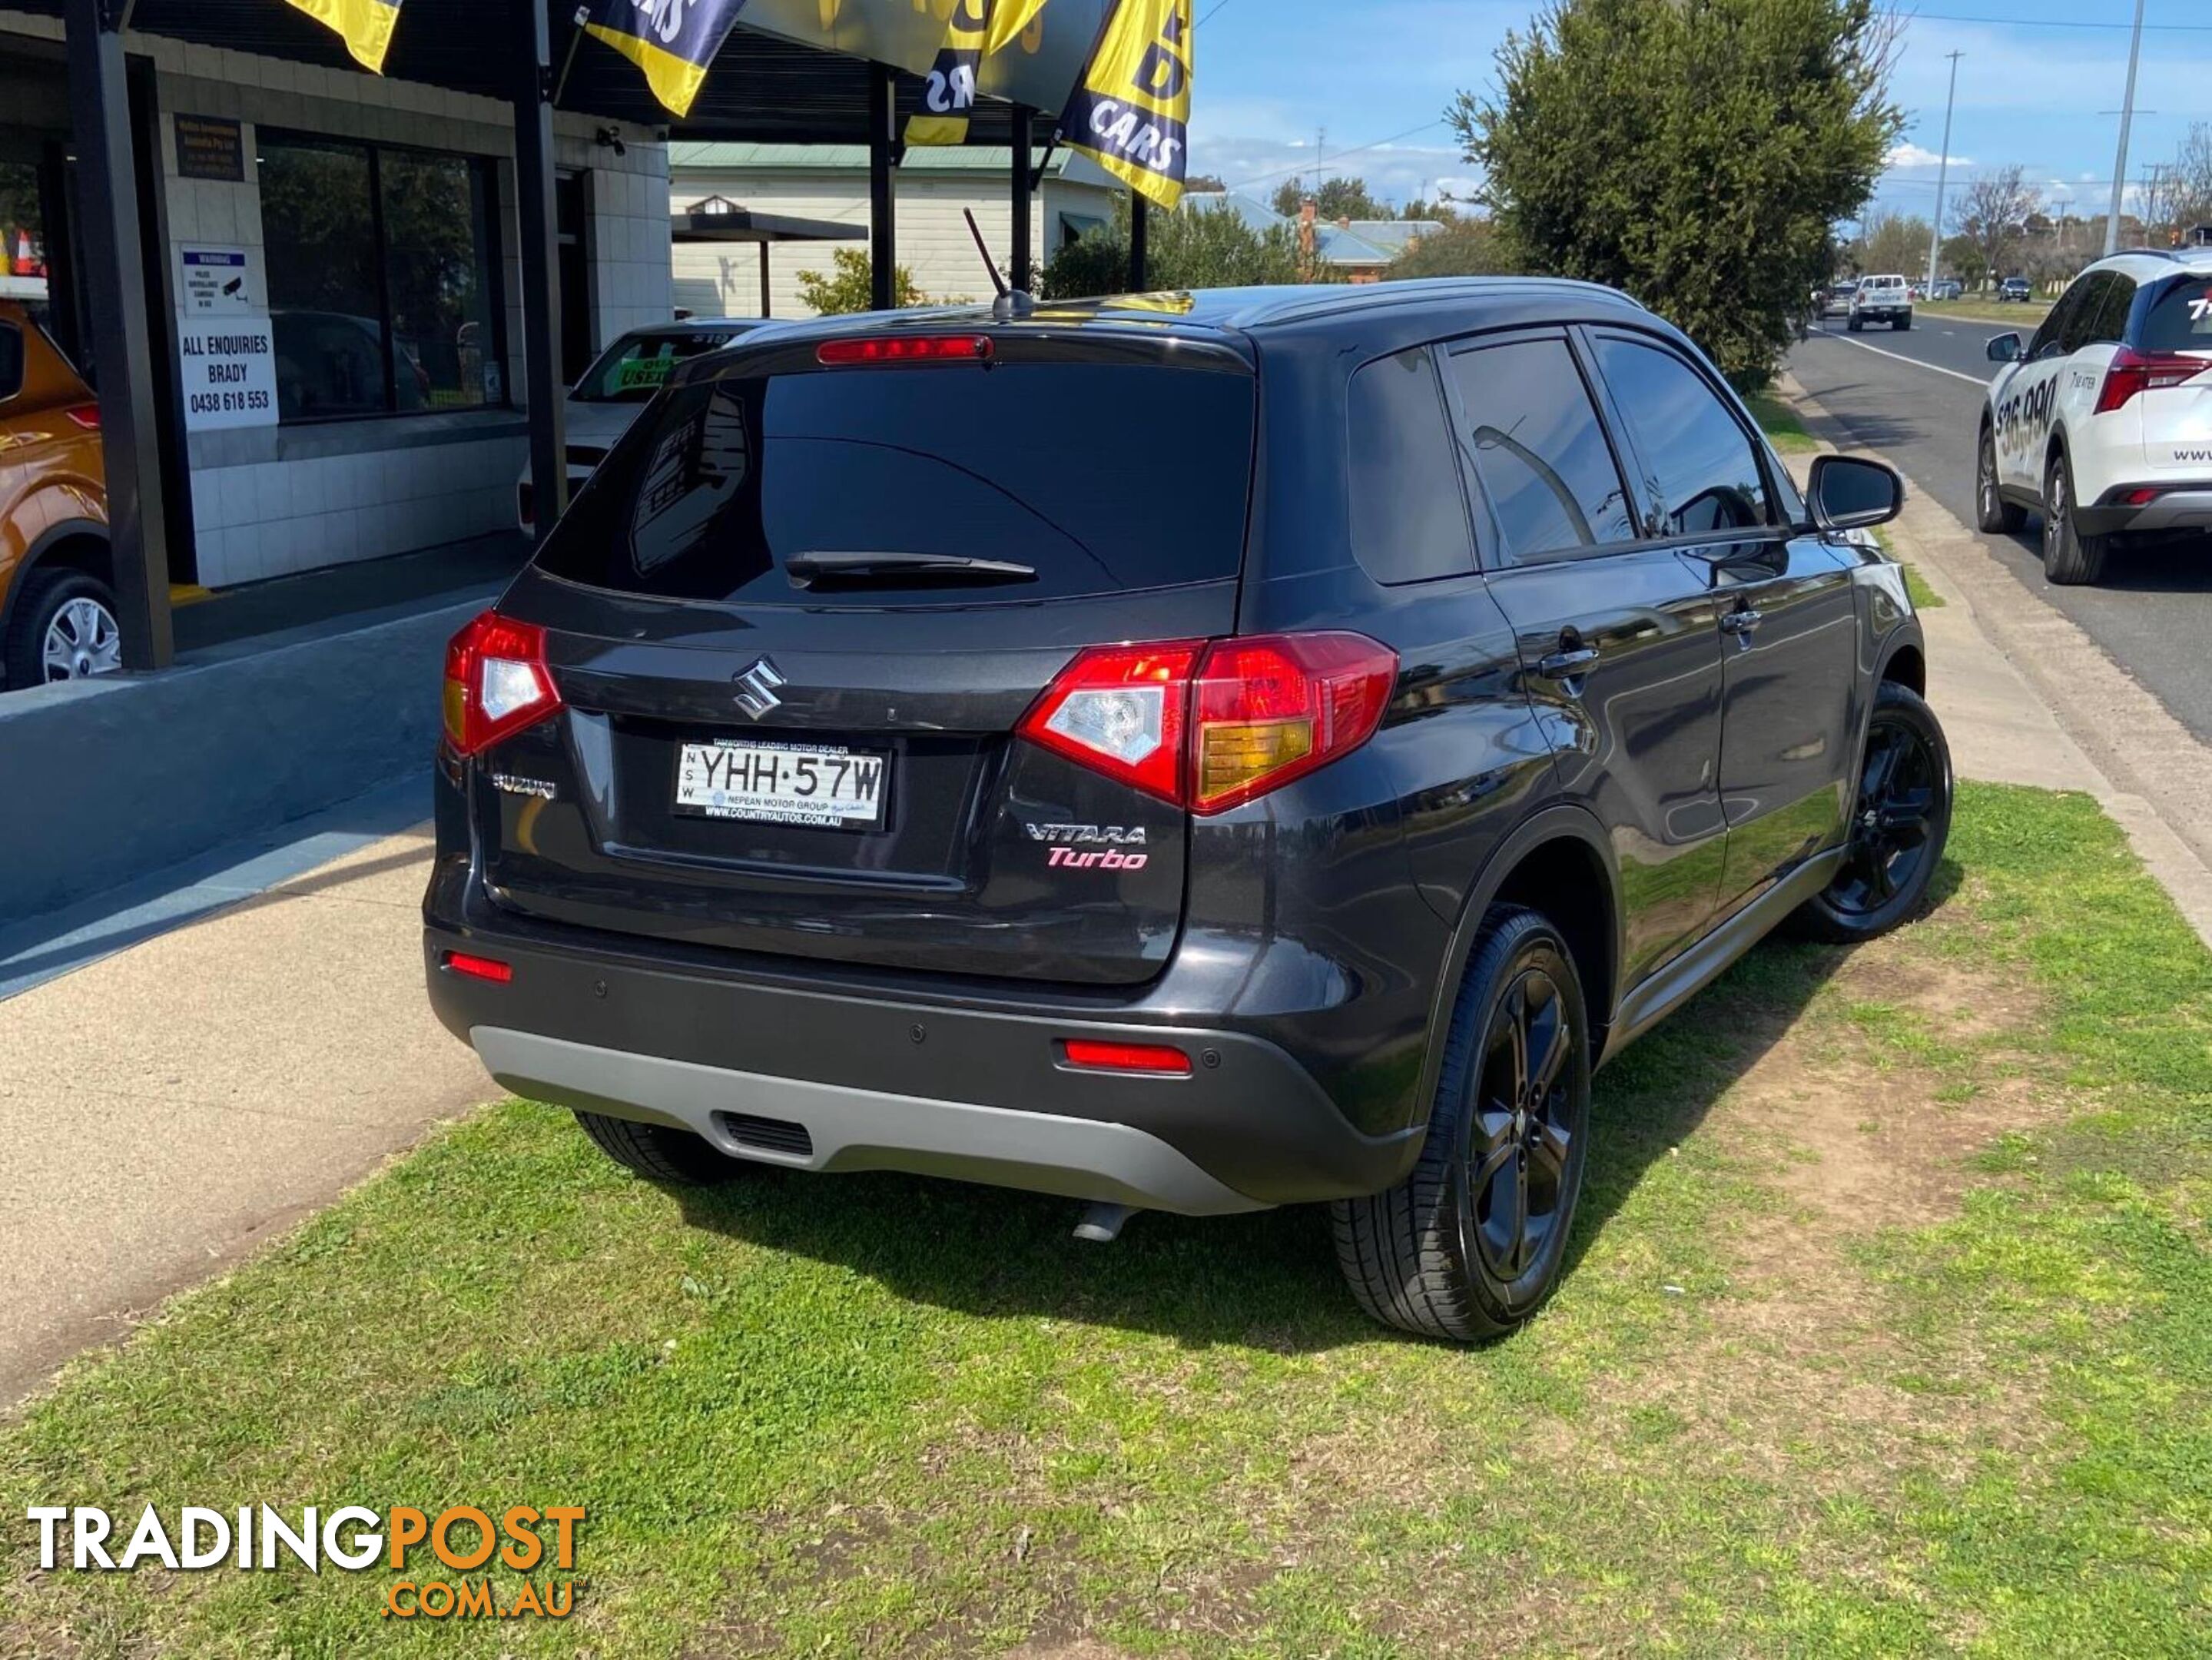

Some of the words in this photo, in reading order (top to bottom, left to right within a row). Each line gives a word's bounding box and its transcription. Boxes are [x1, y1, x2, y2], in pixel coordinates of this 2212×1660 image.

[1089, 100, 1181, 170] CARS
[183, 336, 205, 356] ALL
[207, 335, 268, 357] ENQUIRIES
[208, 364, 247, 383] BRADY
[191, 393, 221, 413] 0438
[223, 392, 245, 410] 618
[247, 390, 269, 409] 553
[758, 741, 788, 750] LEADING
[790, 743, 817, 753] MOTOR
[818, 745, 848, 755] DEALER
[492, 773, 555, 800] SUZUKI
[728, 795, 761, 806] NEPEAN
[763, 798, 795, 808] MOTOR
[798, 800, 829, 812] GROUP
[705, 806, 843, 827] WWW.COUNTRYAUTOS.COM.AU
[1026, 823, 1147, 845] VITARA
[1047, 847, 1149, 870] Turbo
